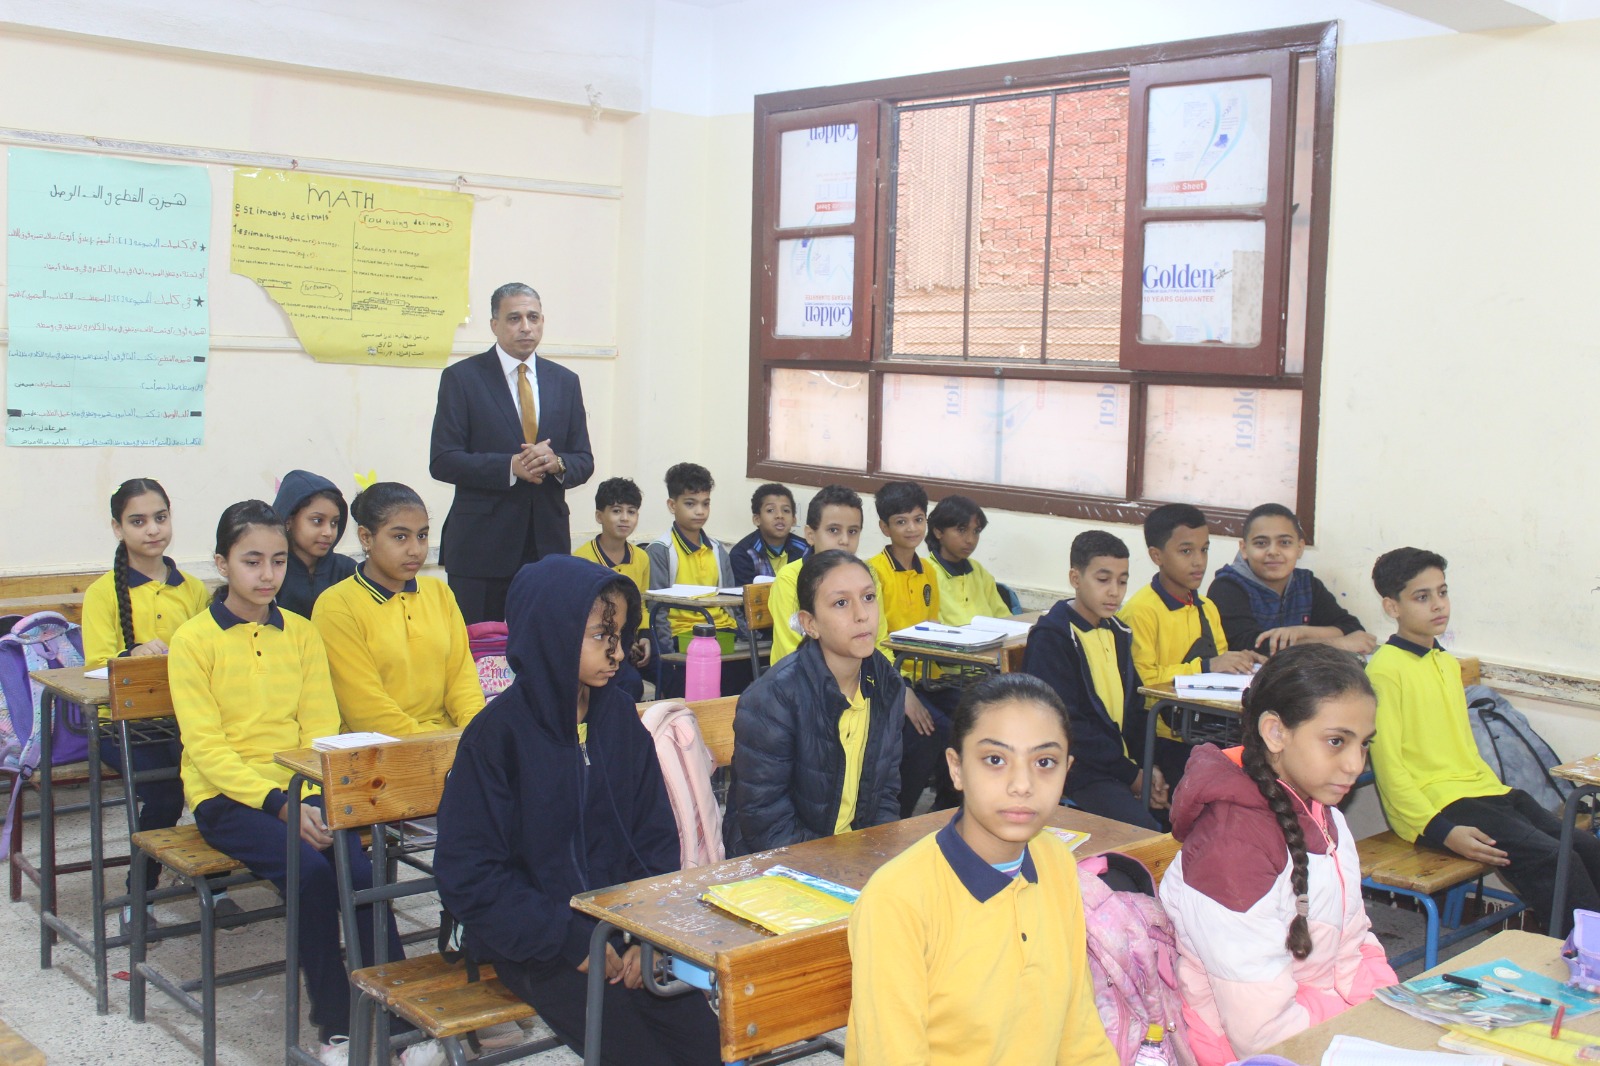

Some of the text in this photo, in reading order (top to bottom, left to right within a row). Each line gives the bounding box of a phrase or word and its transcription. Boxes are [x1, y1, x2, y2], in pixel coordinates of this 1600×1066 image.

[50, 184, 81, 201] الوصل
[114, 187, 144, 206] القطع
[307, 183, 374, 209] MATH
[291, 211, 330, 221] decimals
[1143, 264, 1215, 289] Golden
[805, 306, 853, 327] Golden
